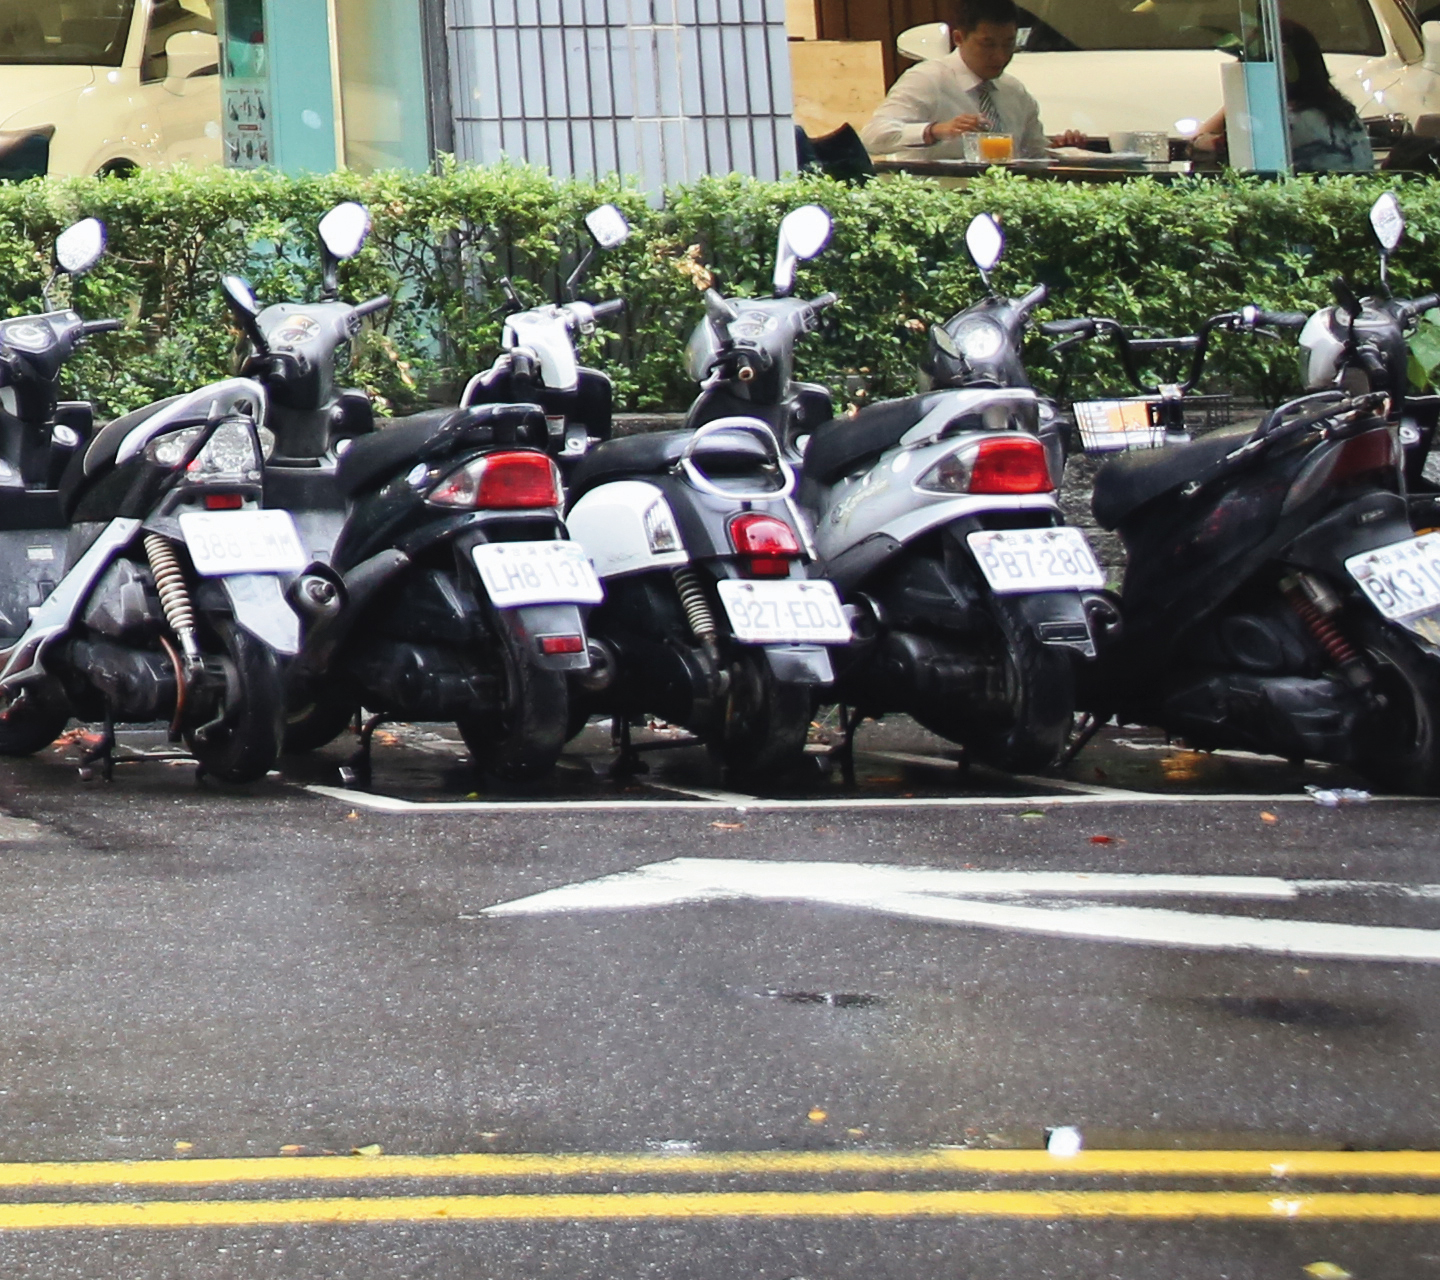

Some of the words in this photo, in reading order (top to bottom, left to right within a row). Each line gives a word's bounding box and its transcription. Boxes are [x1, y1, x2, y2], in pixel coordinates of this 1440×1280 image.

[484, 559, 591, 593] LH8-131
[981, 547, 1095, 581] PB7-280
[731, 599, 842, 629] 927-EDJ
